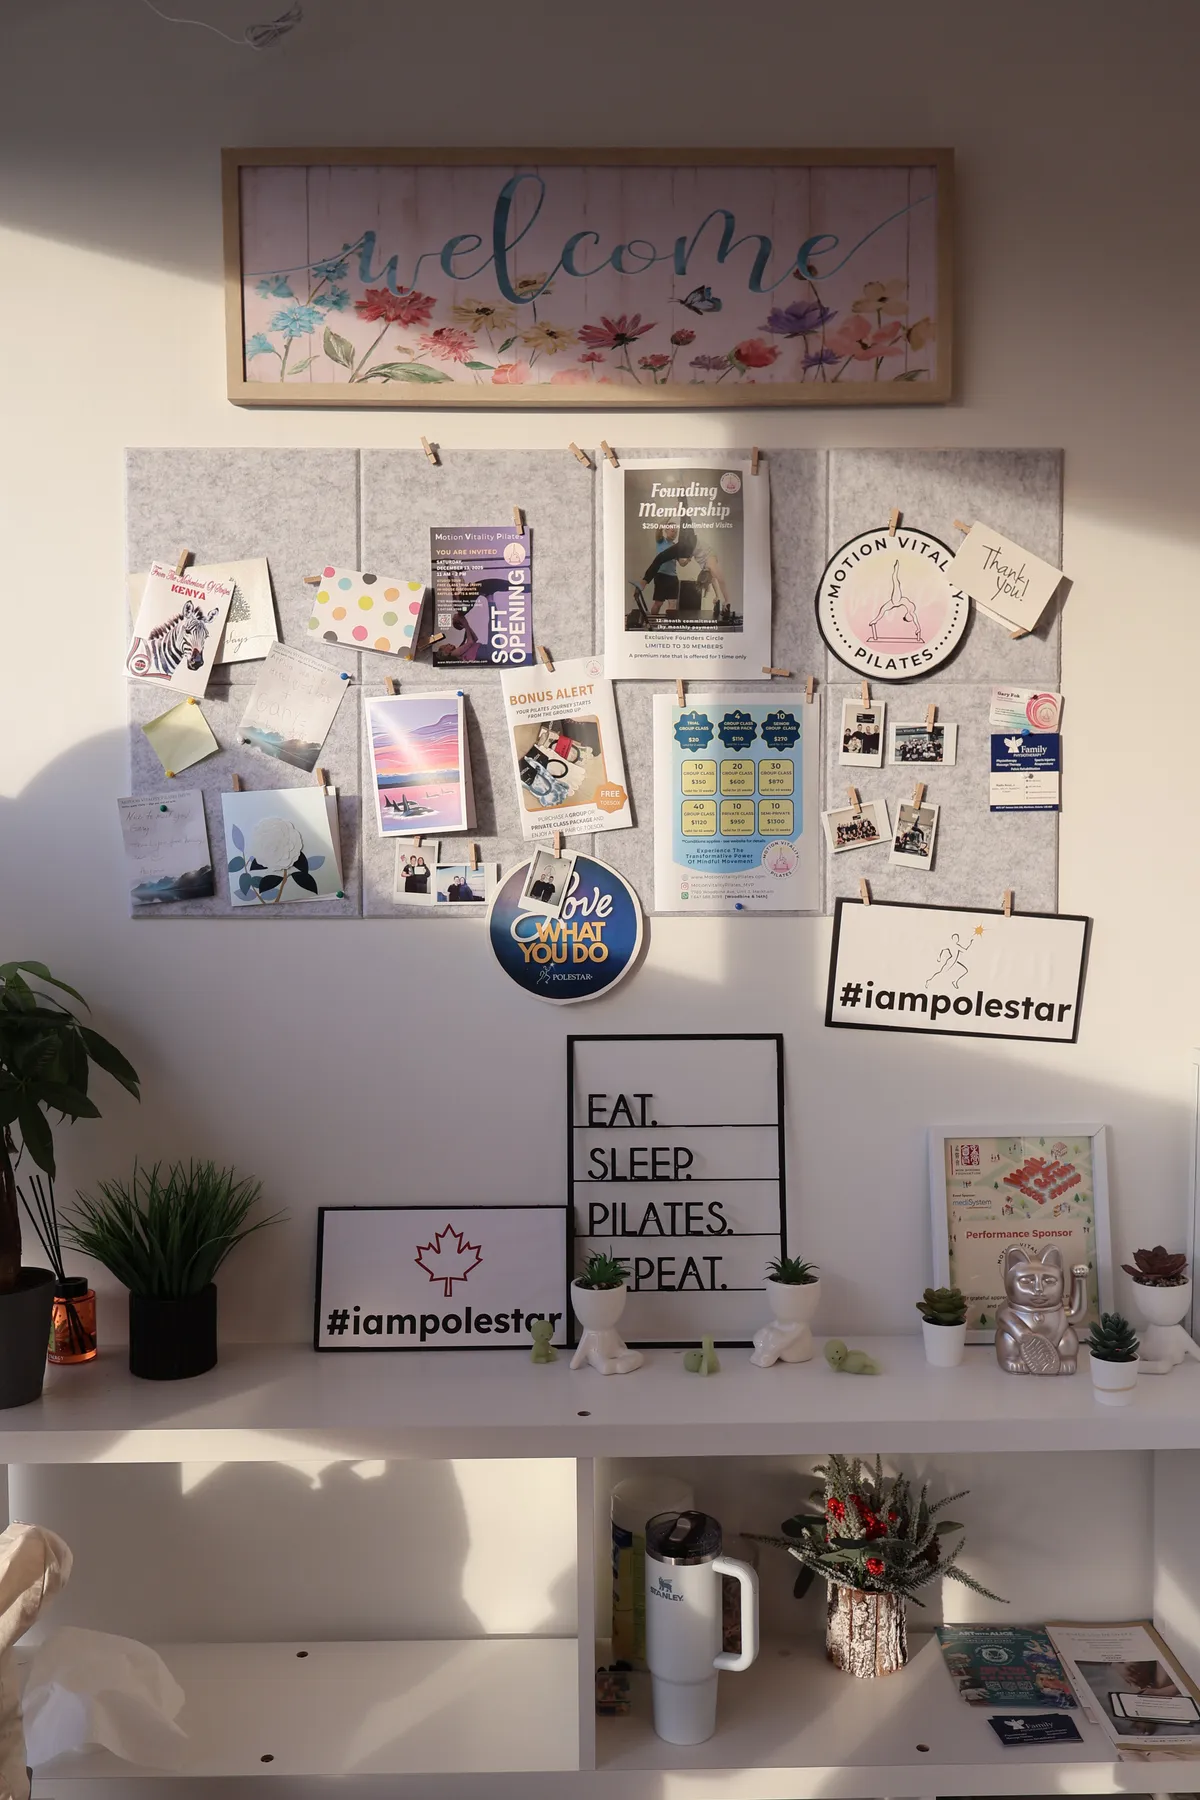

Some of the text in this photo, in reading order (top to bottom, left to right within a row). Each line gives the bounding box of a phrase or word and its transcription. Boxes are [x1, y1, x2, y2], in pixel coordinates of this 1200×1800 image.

[242, 174, 935, 304] welcome
[651, 481, 718, 501] Founding
[639, 501, 731, 521] Membership
[642, 522, 659, 530] $250
[435, 533, 463, 541] Motion
[465, 533, 495, 542] Vitality
[828, 537, 964, 600] MOTION VITALY
[982, 544, 1026, 583] Thank
[171, 584, 206, 600] KENYA
[507, 569, 527, 664] OPENING
[491, 606, 508, 664] SOFT
[854, 647, 933, 670] PILATES
[509, 684, 594, 706] BONUS ALERT
[1021, 745, 1048, 755] Family
[600, 790, 620, 798] FREE
[531, 822, 552, 831] PRIVATE
[553, 820, 569, 828] CLASS
[570, 817, 592, 826] PACKAGE
[537, 813, 564, 822] PURCHASE
[584, 823, 604, 831] TOESOX
[763, 841, 800, 859] MOTION VITALITY
[535, 921, 606, 943] WHAT
[517, 942, 609, 964] YOU DO
[552, 973, 593, 981] POLESTAR
[839, 980, 1072, 1023] #iampolestar
[588, 1093, 658, 1127] EAT.
[587, 1146, 694, 1180] SLEEP.
[953, 1199, 992, 1207] mediSystem
[588, 1201, 733, 1236] PILATES.
[966, 1229, 1073, 1239] Performance Sponsor
[590, 1256, 727, 1291] EPEAT.
[327, 1305, 562, 1342] #iampolestar
[650, 1586, 684, 1602] STANLEY
[1025, 1721, 1053, 1730] Family
